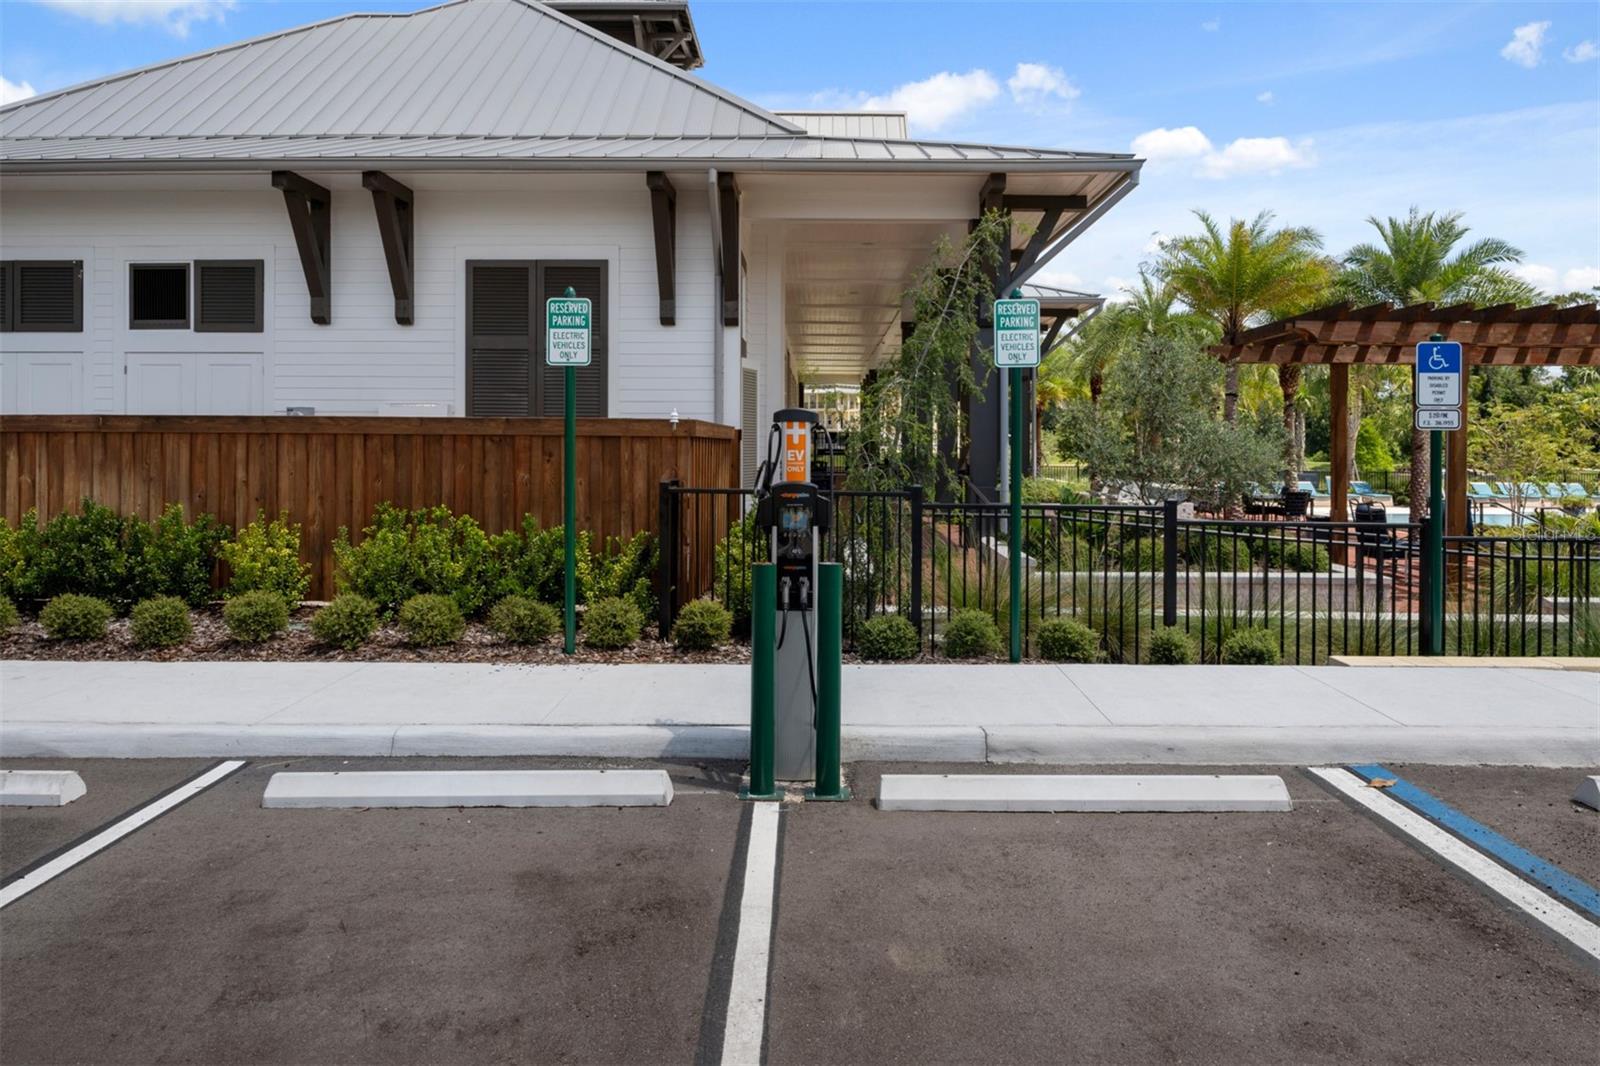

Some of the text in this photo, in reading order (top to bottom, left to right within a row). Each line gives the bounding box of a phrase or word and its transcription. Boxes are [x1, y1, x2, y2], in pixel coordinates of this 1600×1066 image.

[550, 302, 588, 314] RESERVED
[997, 303, 1036, 315] RESERVED
[552, 315, 586, 326] PARKING
[1000, 316, 1034, 328] PARKING
[553, 332, 585, 340] ELECTRIC
[1000, 333, 1034, 341] ELECTRIC
[552, 341, 585, 350] VEHICLES
[1000, 343, 1035, 351] VEHICLES
[559, 351, 578, 359] ONLY
[1008, 352, 1027, 361] ONLY
[787, 450, 805, 461] EV
[787, 465, 805, 473] ONLY
